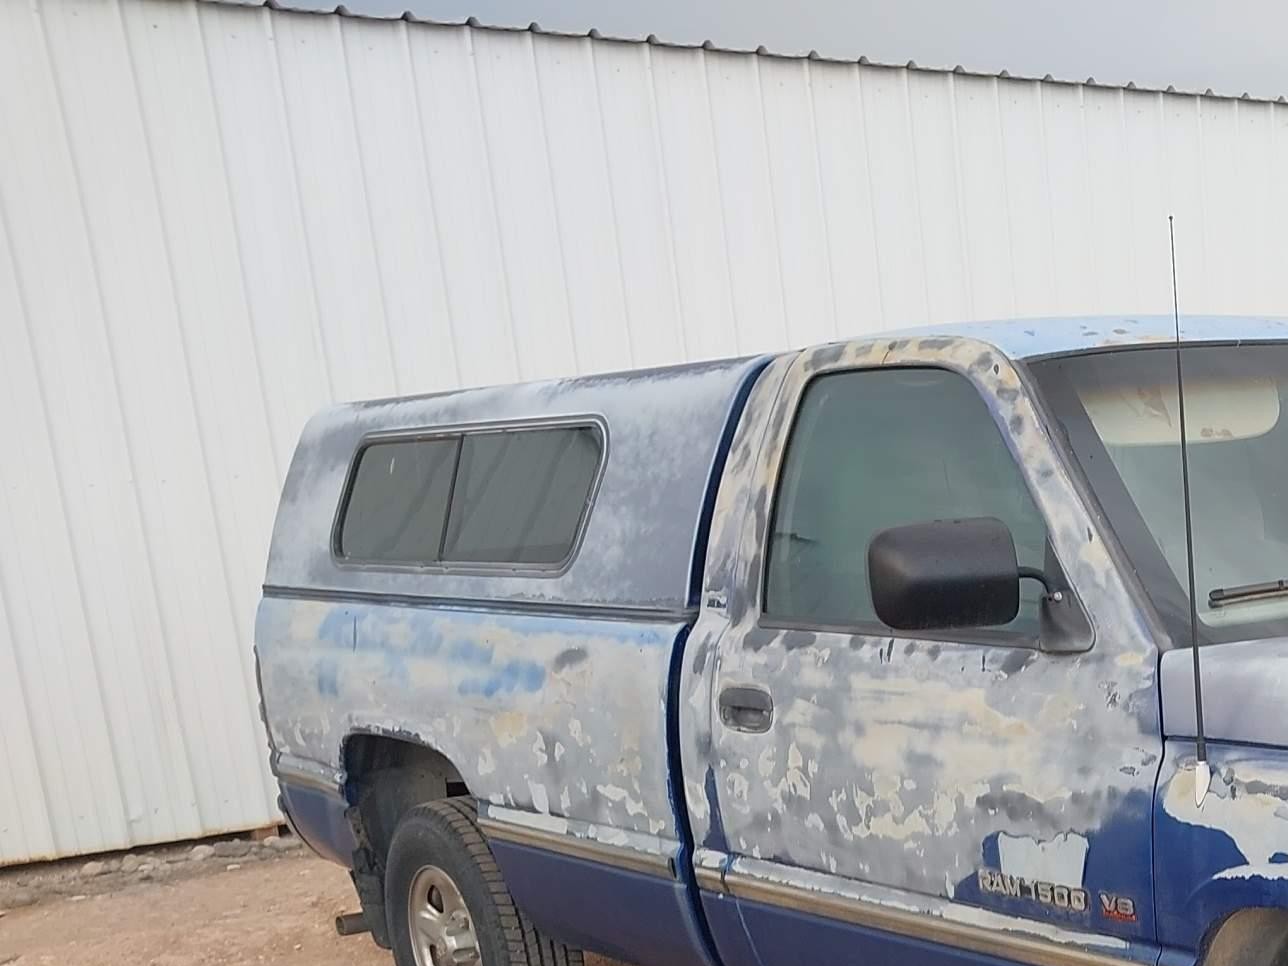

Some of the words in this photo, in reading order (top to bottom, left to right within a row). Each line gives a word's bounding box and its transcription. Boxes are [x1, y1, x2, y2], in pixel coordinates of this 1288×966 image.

[978, 869, 1021, 896] RAM
[1026, 879, 1086, 911] 1500
[1098, 890, 1136, 914] V8
